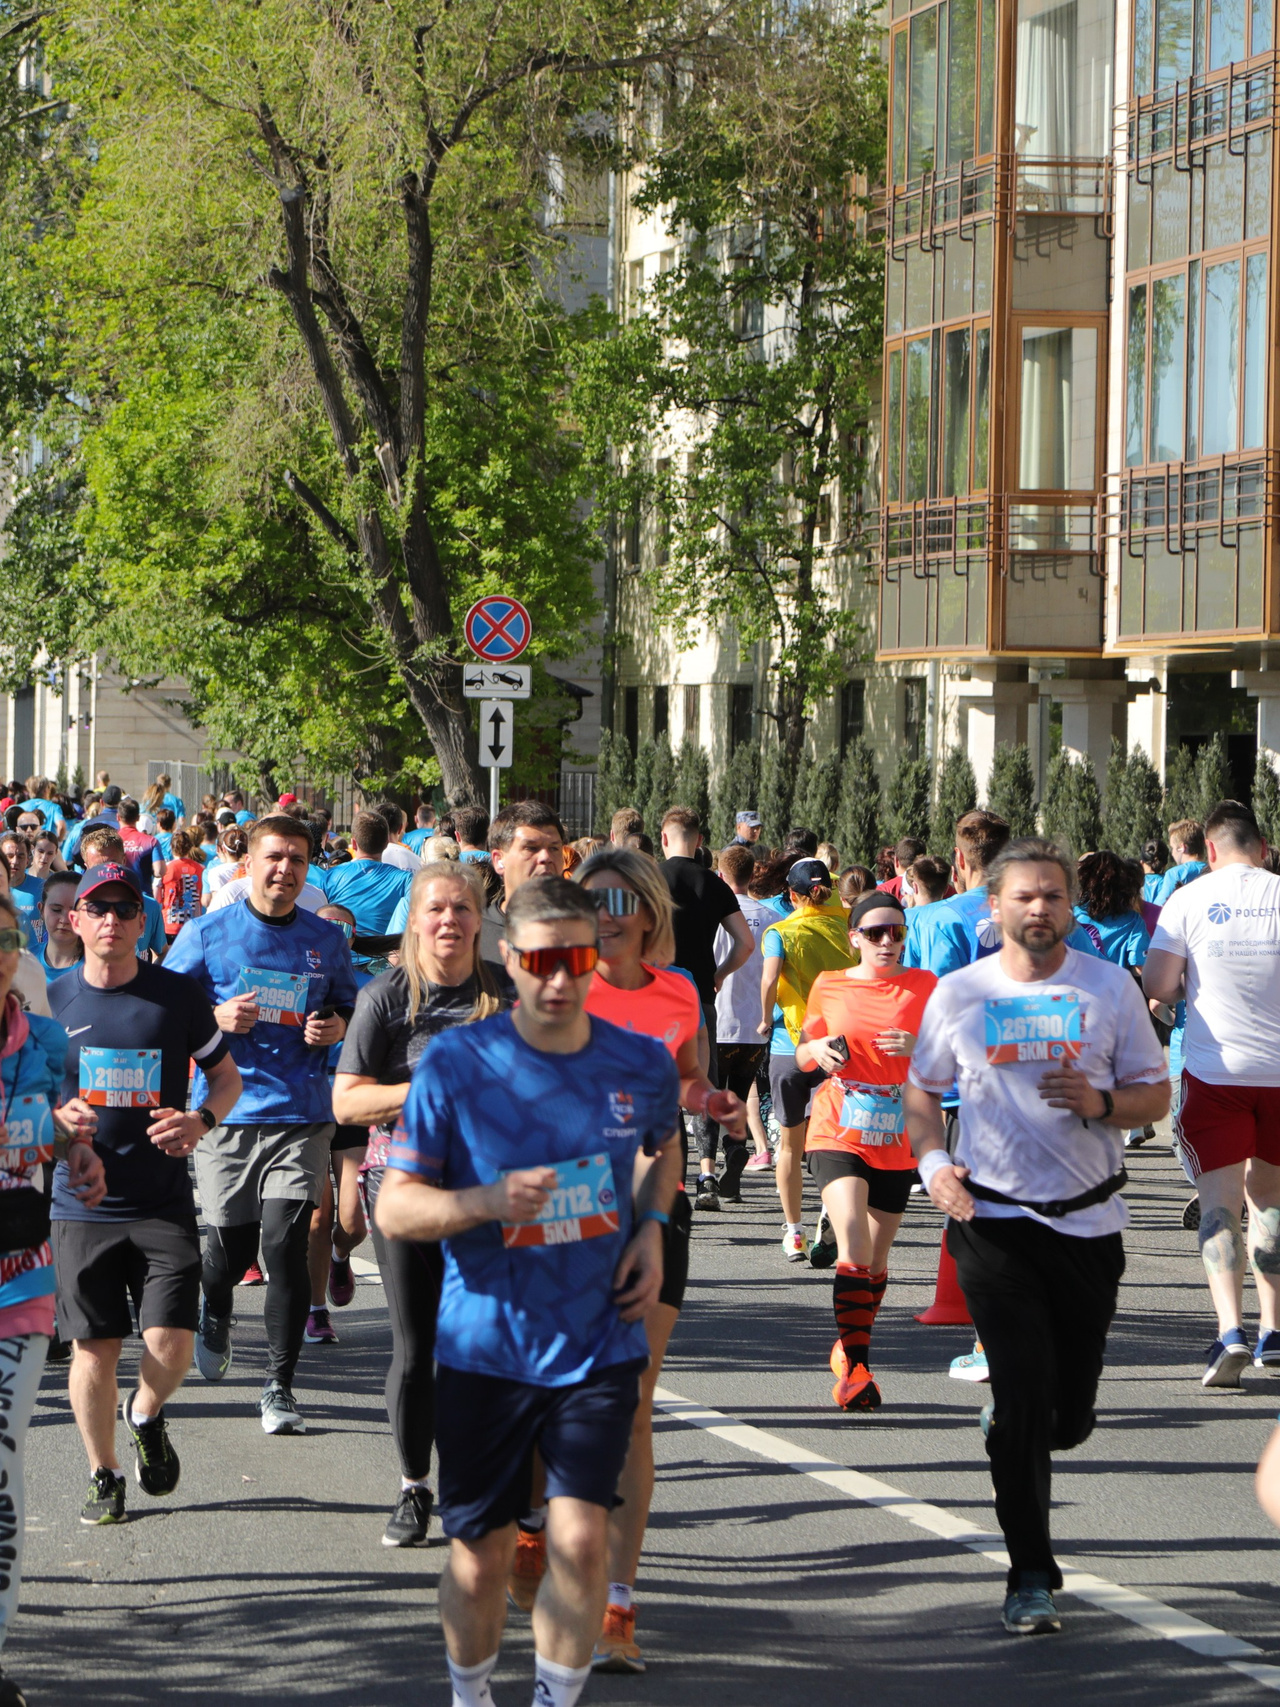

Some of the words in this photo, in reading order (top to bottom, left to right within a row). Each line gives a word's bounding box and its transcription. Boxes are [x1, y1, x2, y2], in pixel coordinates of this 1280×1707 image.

[746, 918, 760, 927] СБ
[1235, 948, 1258, 957] НАШЕЙ
[303, 971, 325, 980] СПОРТ
[257, 1007, 282, 1025] 5KM
[1001, 1013, 1064, 1042] 26790
[1017, 1041, 1049, 1062] 5KM
[95, 1067, 145, 1089] 21968
[106, 1090, 133, 1107] 5KM
[851, 1107, 897, 1132] 26438
[602, 1126, 638, 1139] СПОРТ
[860, 1130, 884, 1147] 5KM
[543, 1218, 583, 1246] 5KM
